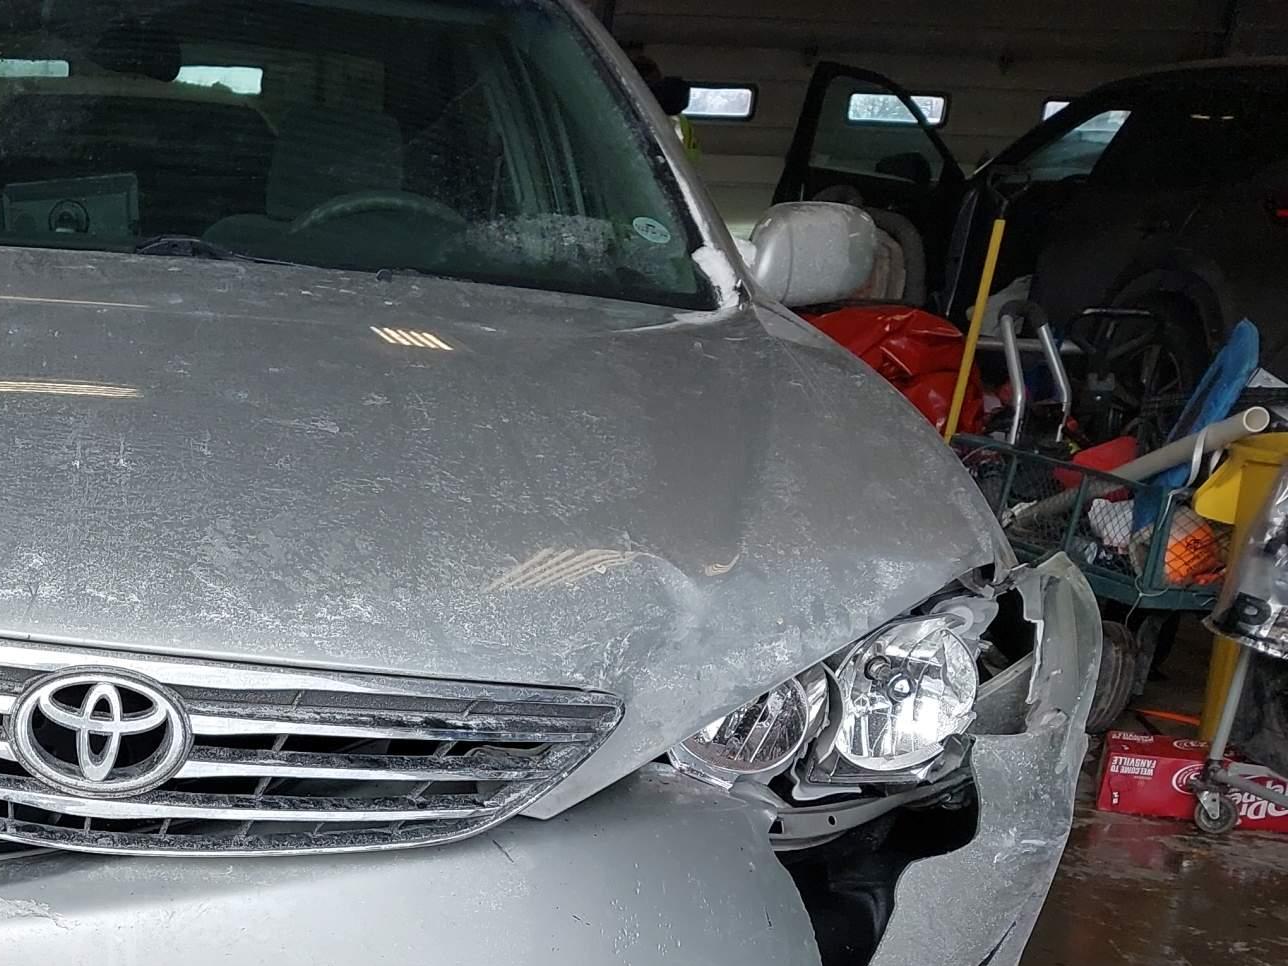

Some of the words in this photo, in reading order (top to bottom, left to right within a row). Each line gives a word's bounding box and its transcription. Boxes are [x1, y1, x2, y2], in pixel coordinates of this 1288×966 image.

[1111, 755, 1157, 769] FANSVILLE
[1110, 764, 1120, 773] TO
[1119, 765, 1154, 776] WELCOME
